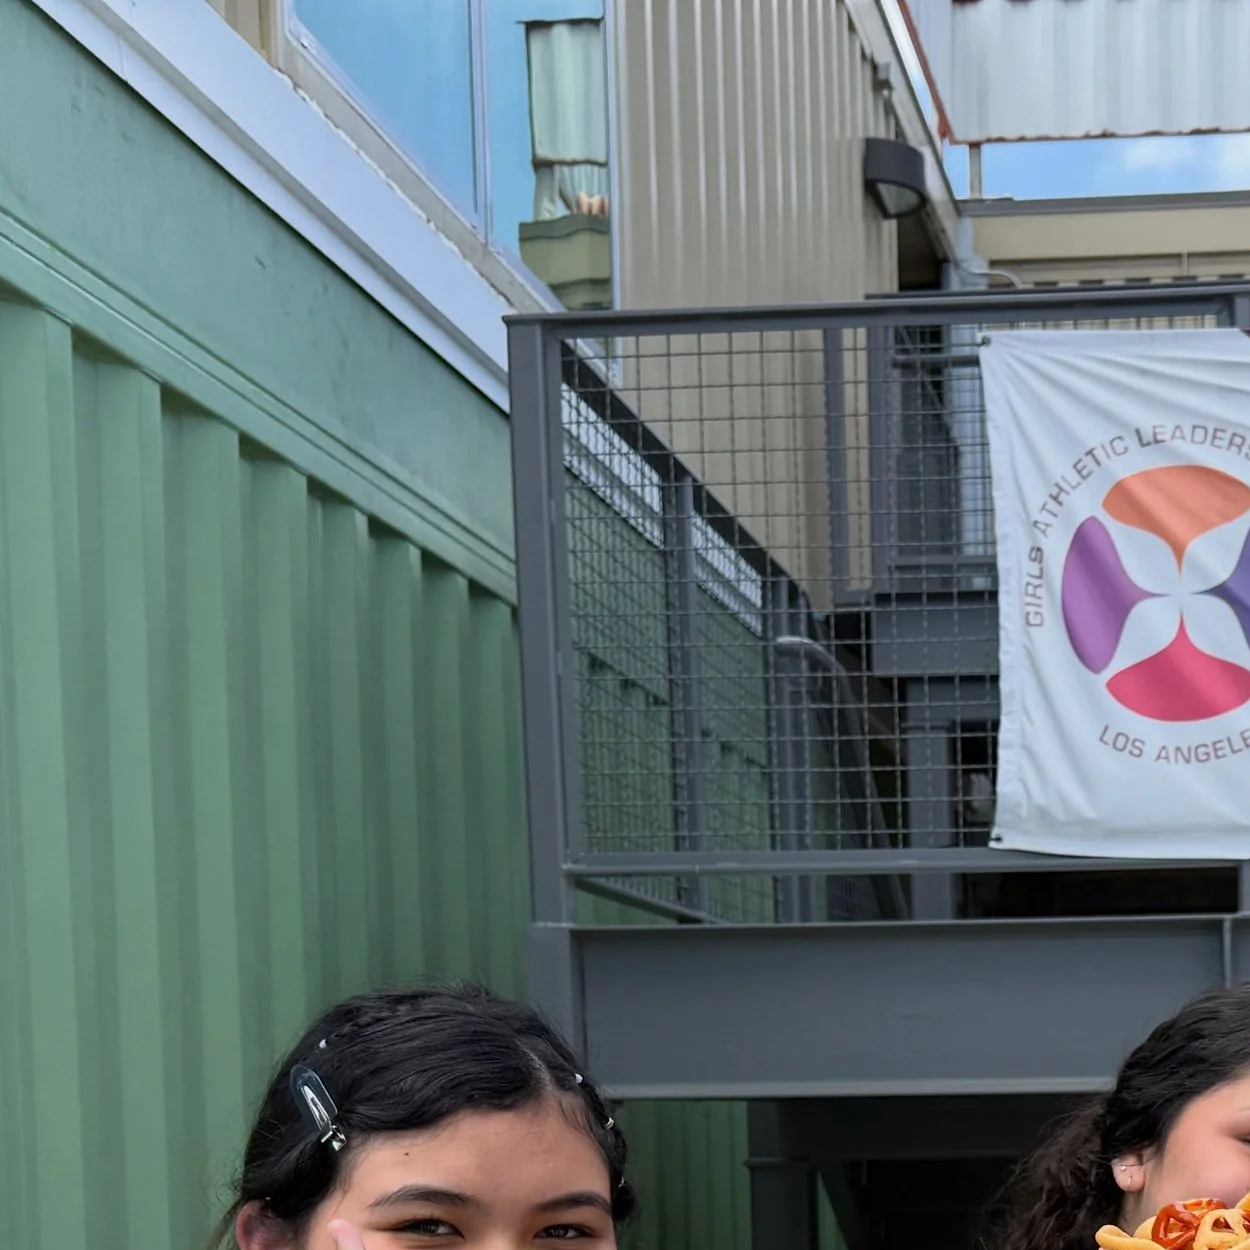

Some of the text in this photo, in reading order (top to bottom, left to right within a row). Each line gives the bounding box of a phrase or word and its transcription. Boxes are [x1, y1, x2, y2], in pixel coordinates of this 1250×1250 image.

[1032, 435, 1129, 538] ATHLETIC
[1025, 545, 1045, 628] GIRLS
[1099, 724, 1145, 758] LOS
